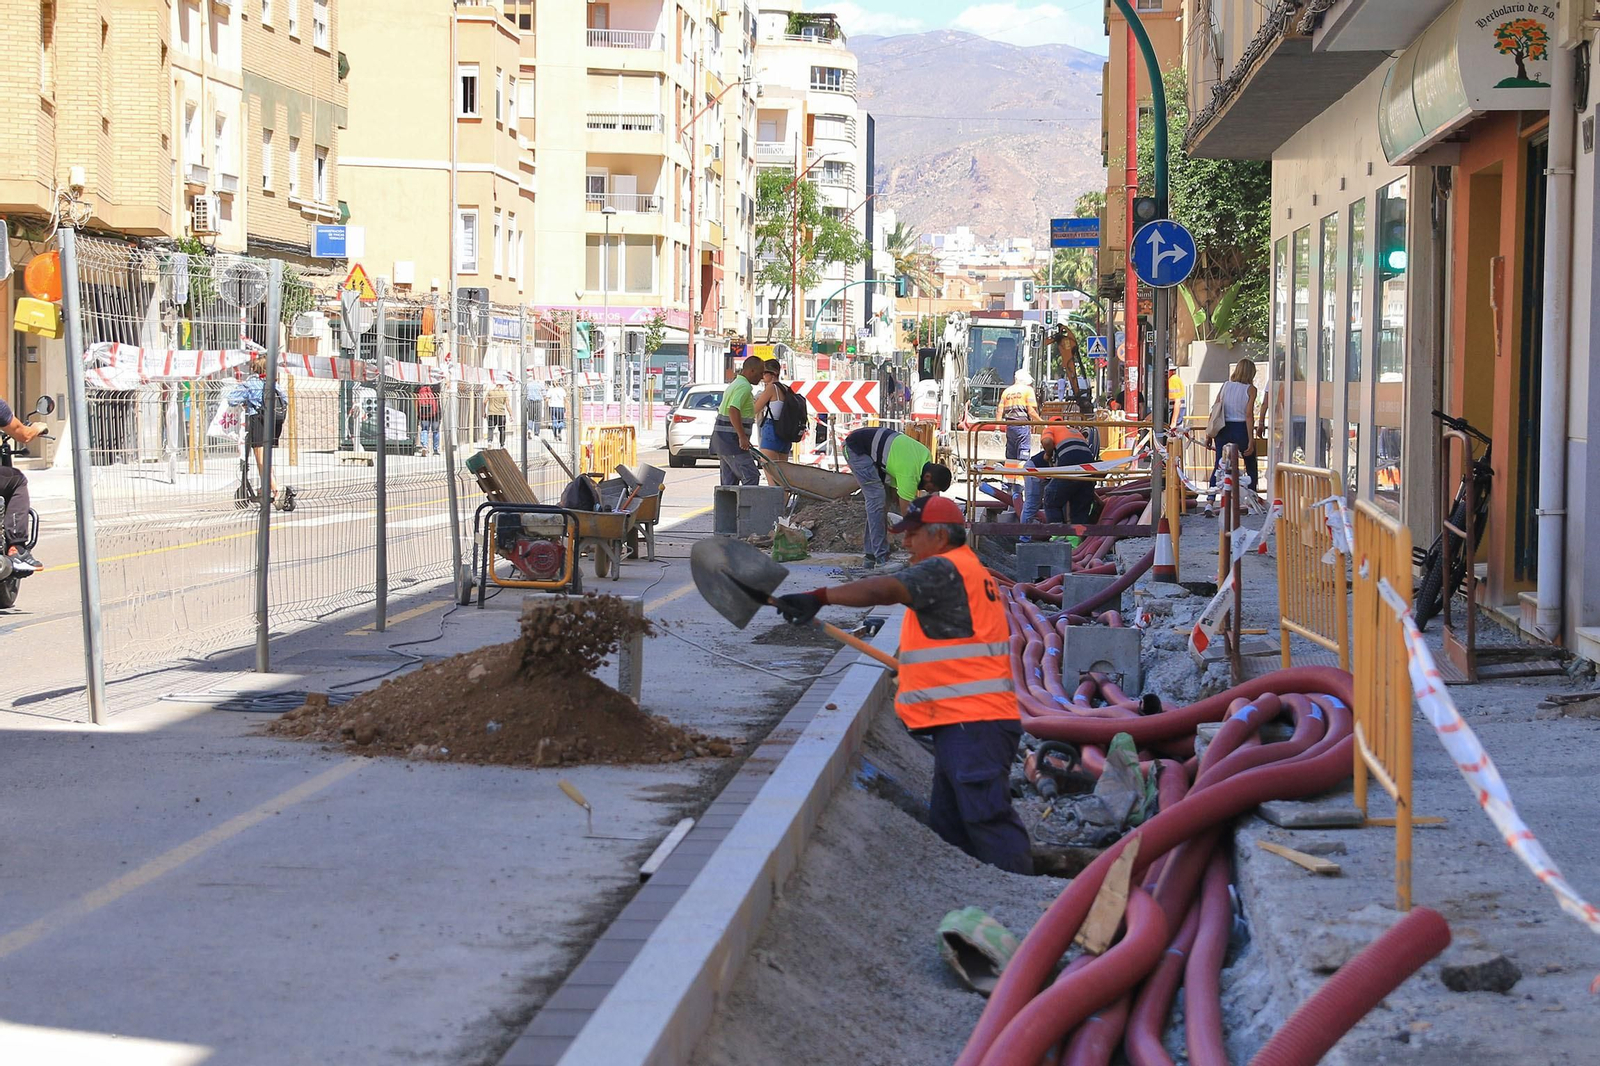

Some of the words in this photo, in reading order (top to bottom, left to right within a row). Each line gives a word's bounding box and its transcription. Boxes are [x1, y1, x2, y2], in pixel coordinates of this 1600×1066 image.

[1475, 2, 1525, 29] Herbolario
[1528, 2, 1539, 13] de
[1541, 5, 1555, 20] Lo
